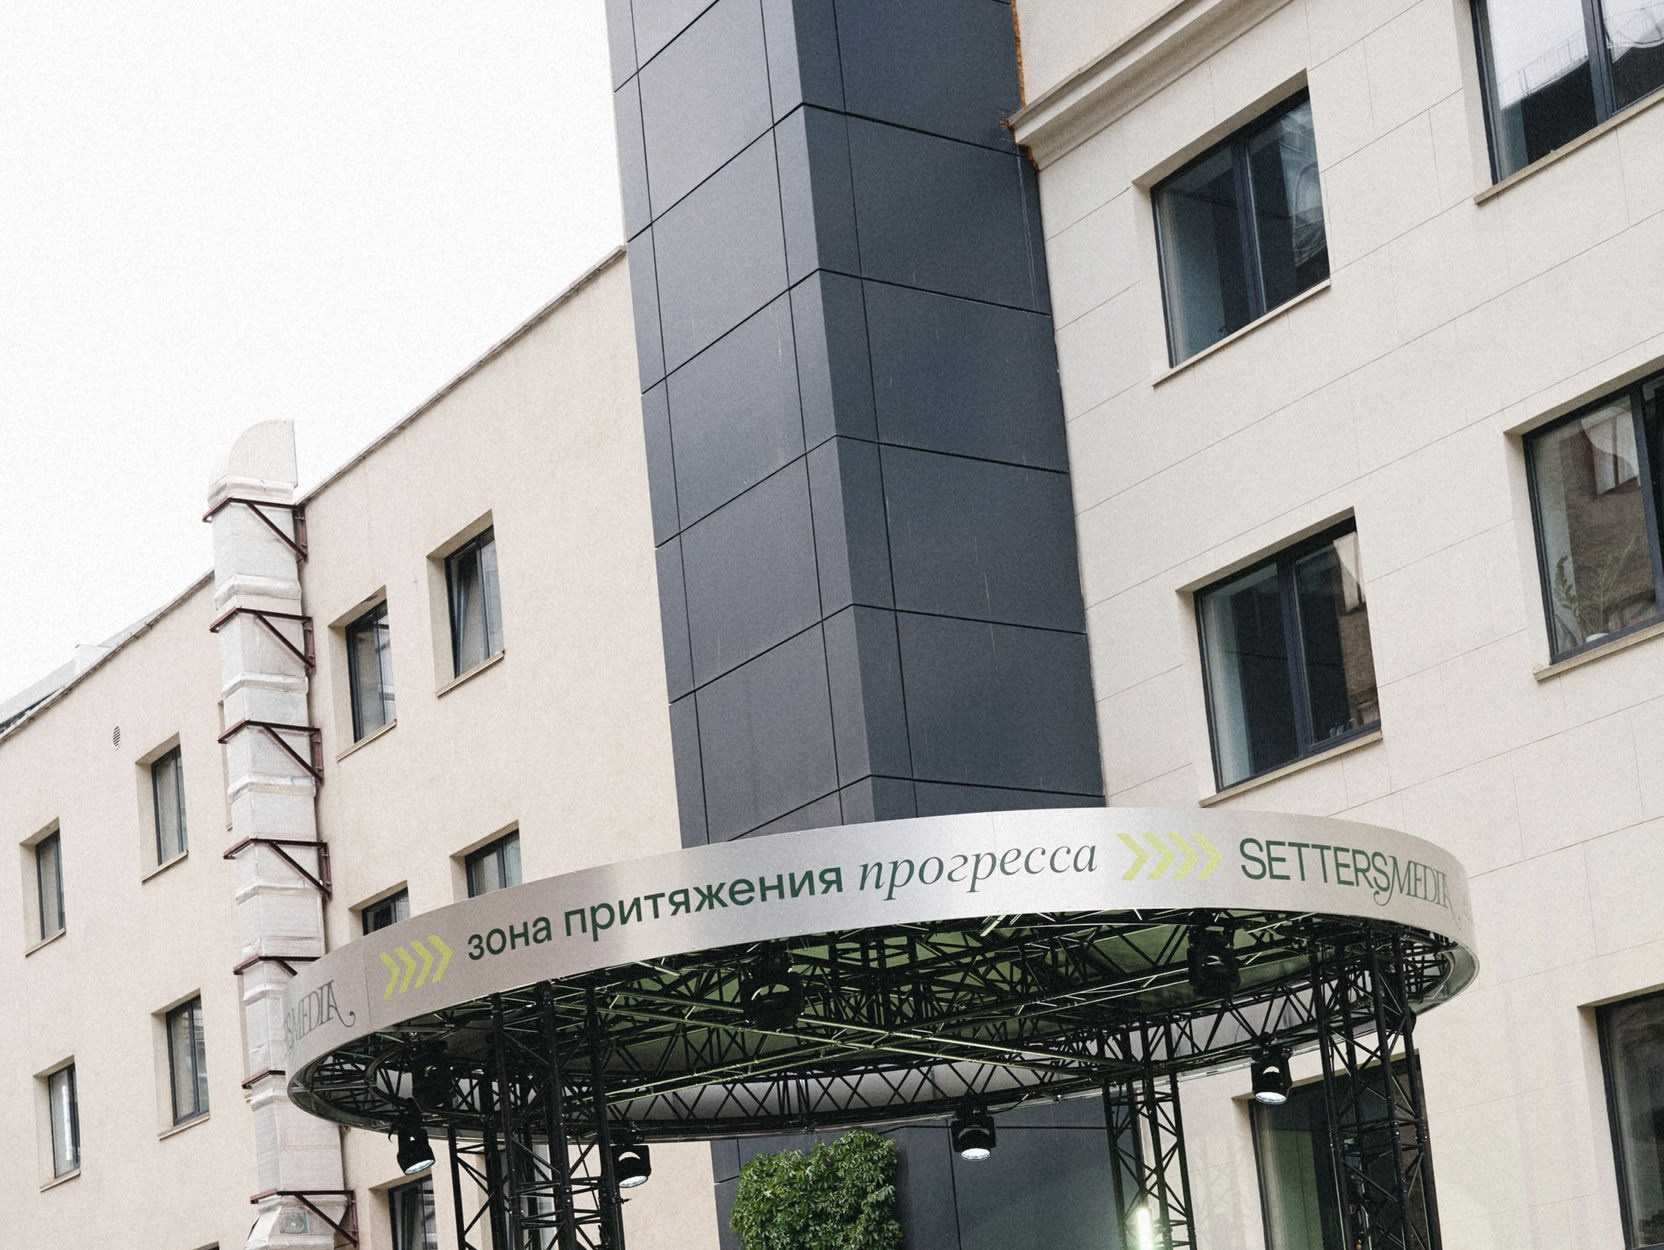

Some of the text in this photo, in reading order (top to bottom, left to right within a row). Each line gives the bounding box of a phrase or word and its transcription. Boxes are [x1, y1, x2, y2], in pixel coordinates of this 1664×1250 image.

[467, 844, 1098, 961] зона притяжения прогресса
